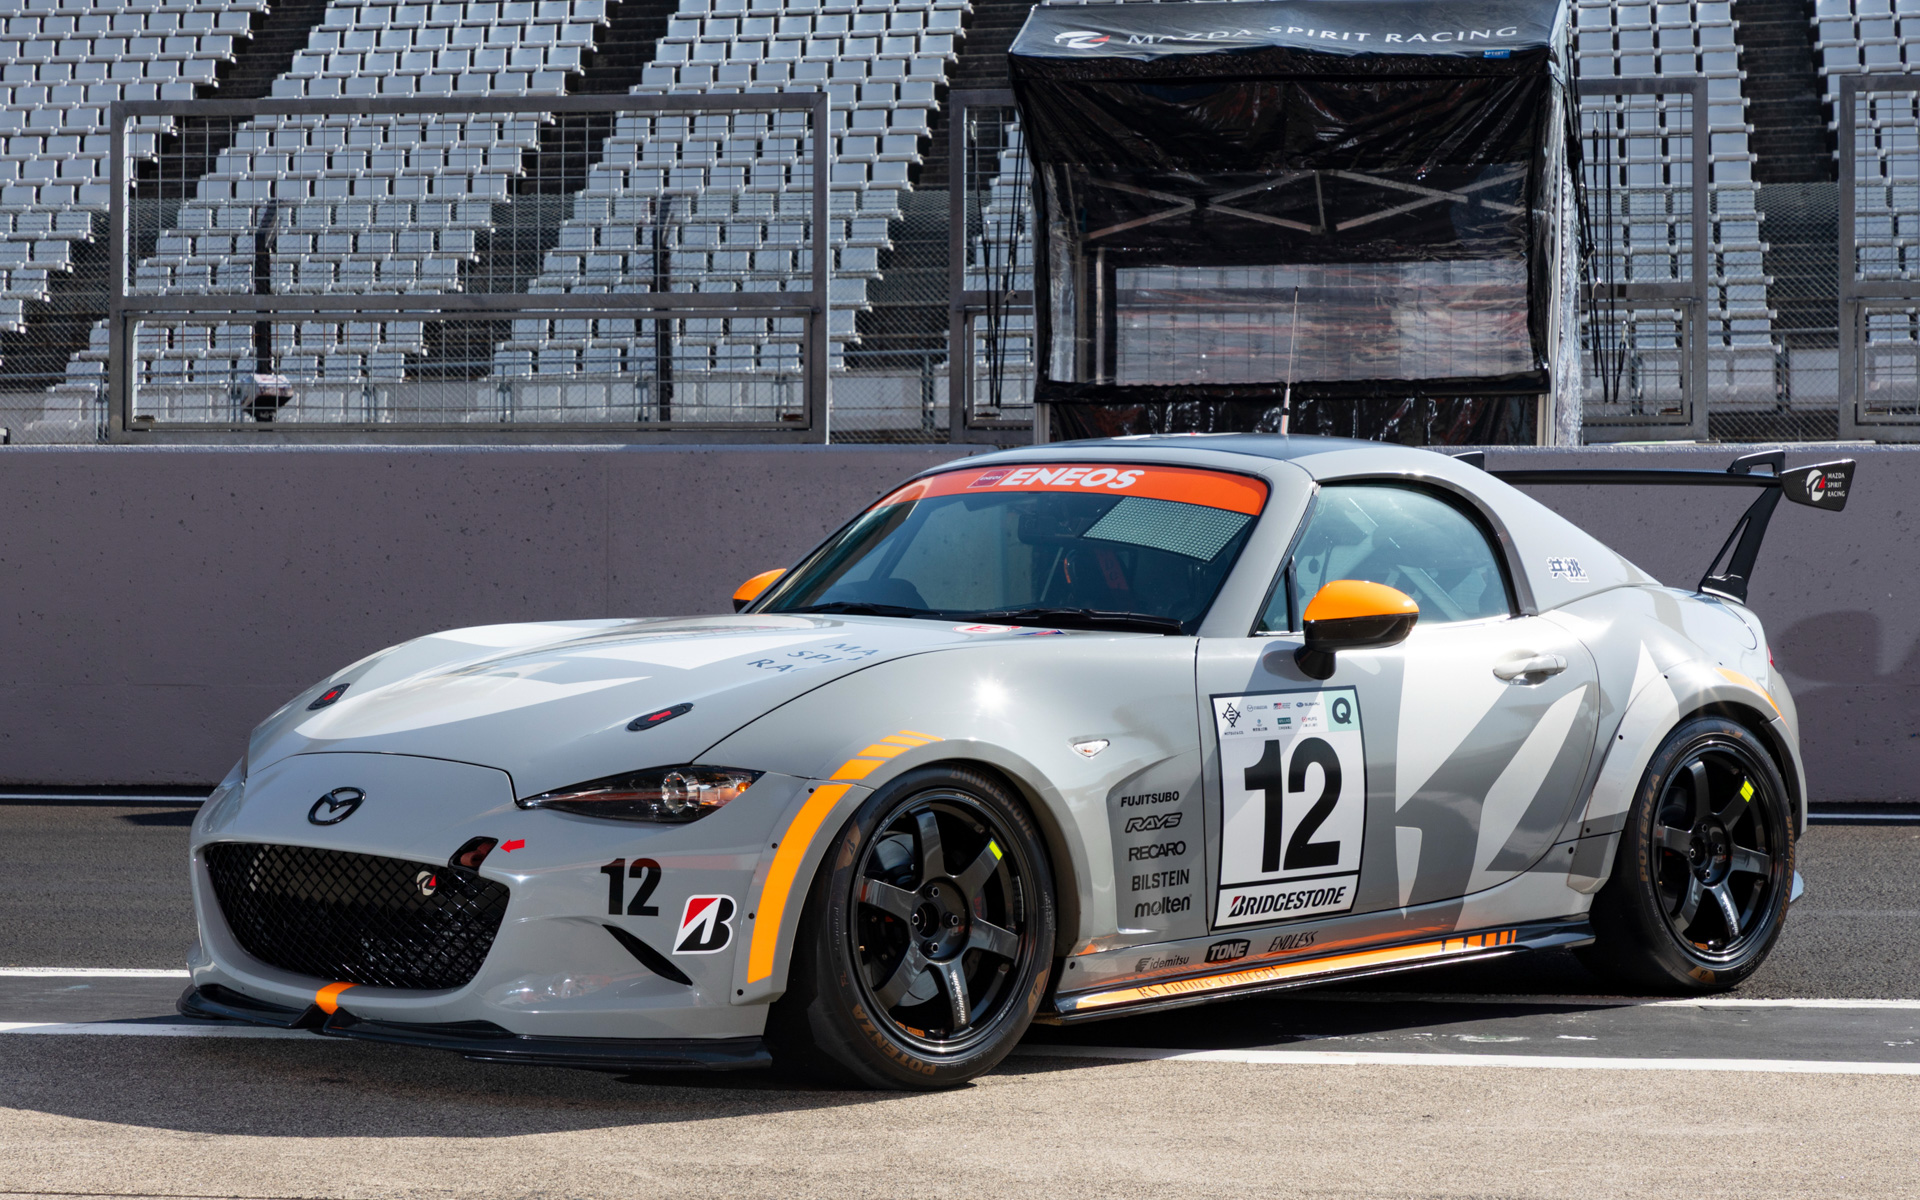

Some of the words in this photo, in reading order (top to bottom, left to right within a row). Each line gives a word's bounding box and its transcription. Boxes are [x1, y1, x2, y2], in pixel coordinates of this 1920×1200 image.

[1127, 29, 1252, 45] MAZDA
[1266, 25, 1372, 43] SPIRIT
[1385, 26, 1517, 42] RACING
[998, 467, 1145, 489] ENEOS
[1332, 697, 1352, 724] Q
[1120, 791, 1179, 807] FUJITSUBO
[1244, 737, 1342, 873] 12
[1125, 813, 1182, 833] RAYS
[1639, 773, 1660, 882] POTENZA
[1128, 841, 1186, 861] RECARO
[1132, 869, 1190, 891] BILSTEIN
[1776, 815, 1795, 923] BRIDGESTONE
[601, 858, 662, 916] 12
[1135, 896, 1190, 918] molten
[1228, 886, 1346, 917] BRIDGESTONE
[1211, 942, 1248, 960] TONE
[1268, 931, 1319, 952] ENDLESS
[1150, 955, 1189, 969] idemitsu
[852, 1003, 937, 1075] POTENZA
